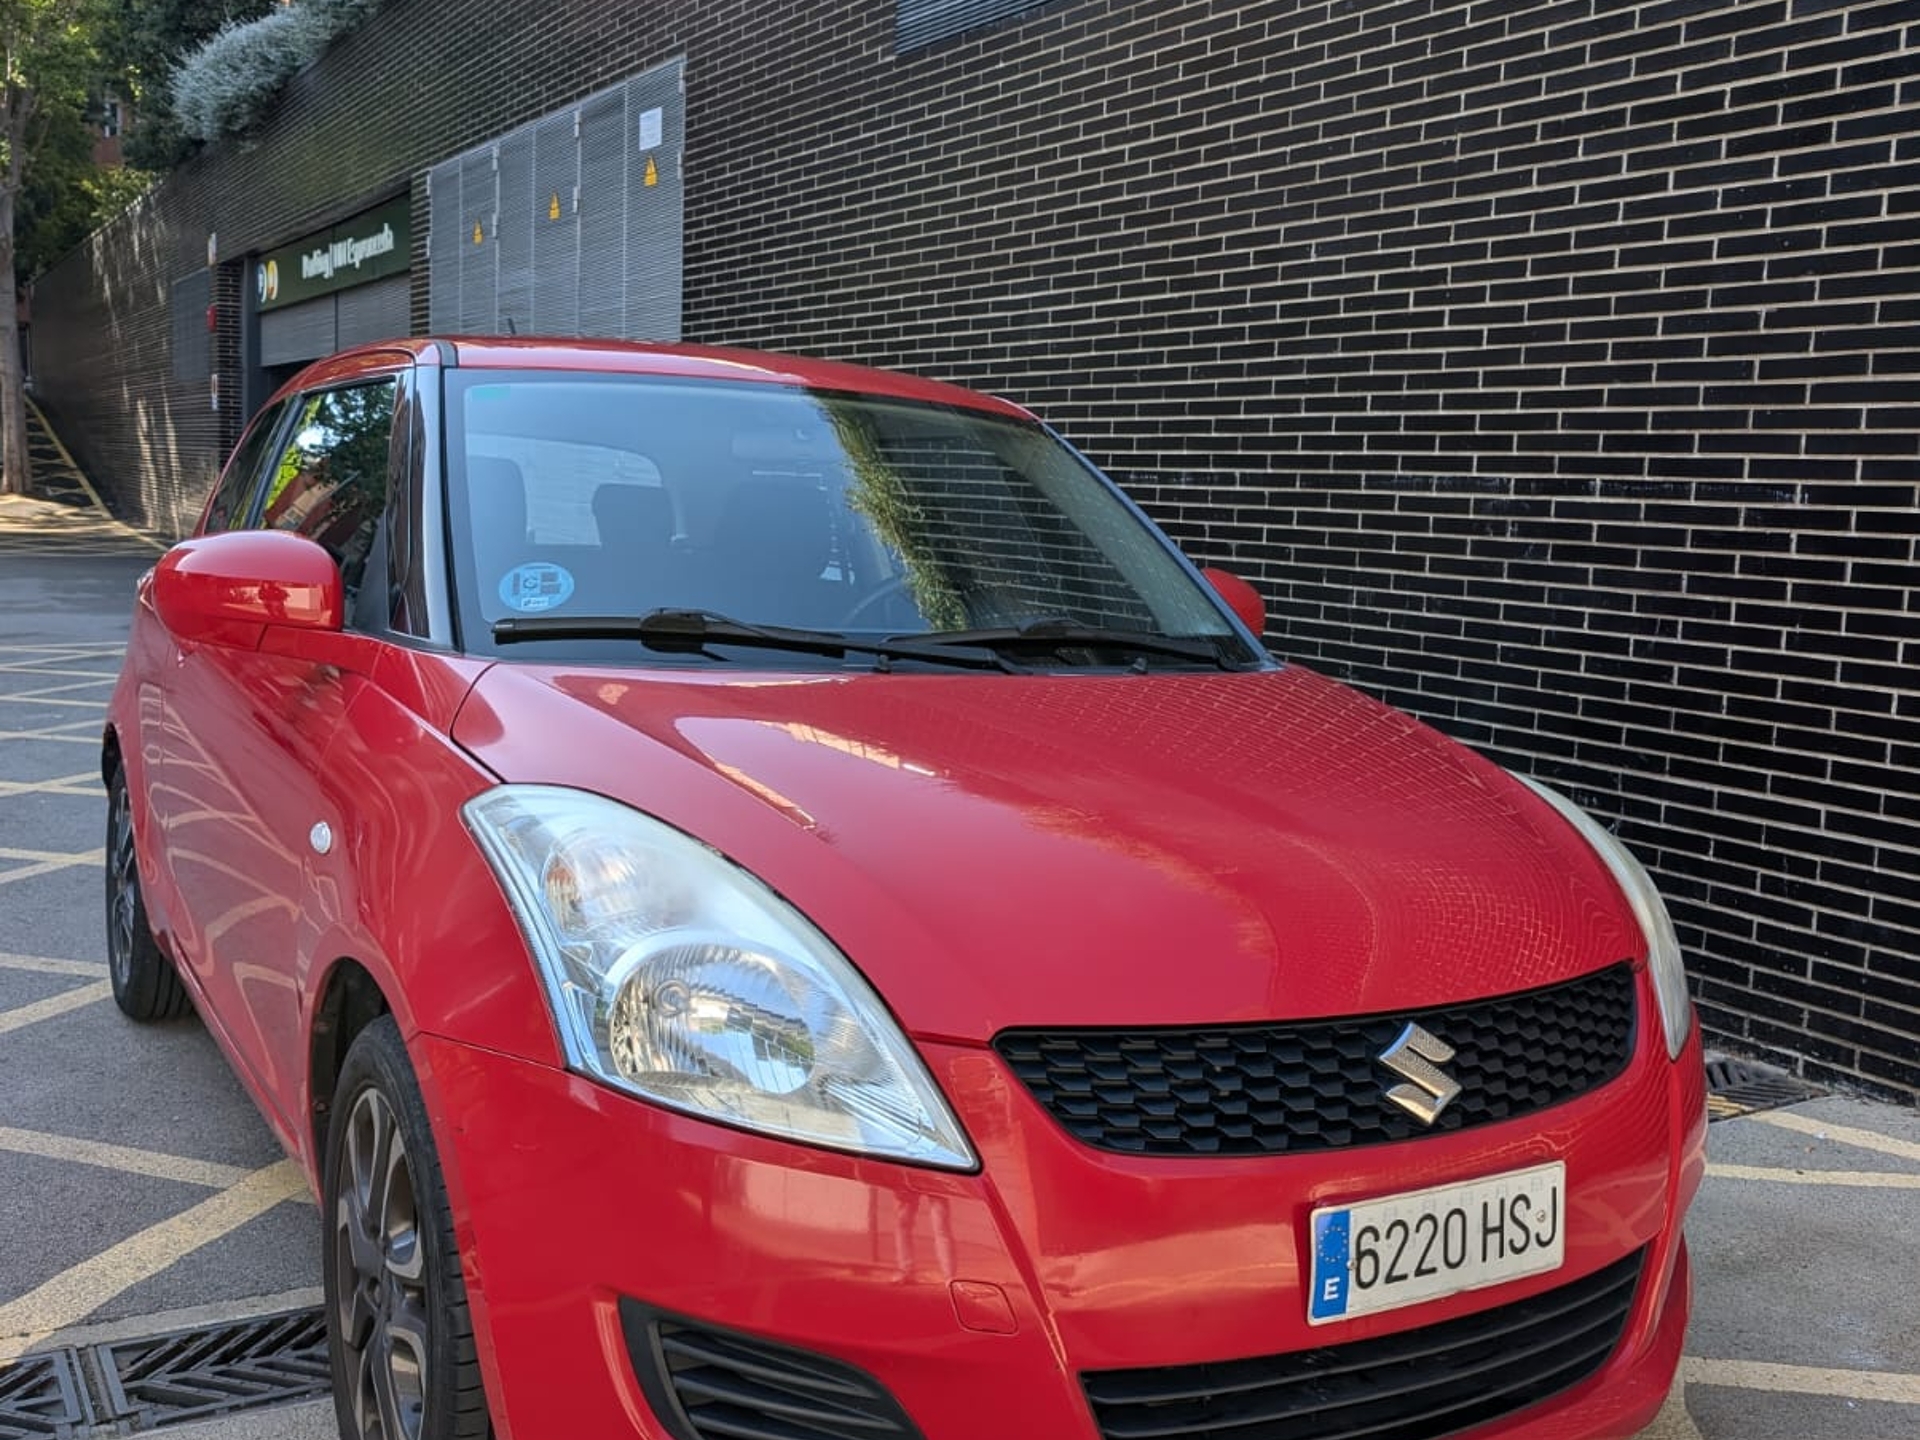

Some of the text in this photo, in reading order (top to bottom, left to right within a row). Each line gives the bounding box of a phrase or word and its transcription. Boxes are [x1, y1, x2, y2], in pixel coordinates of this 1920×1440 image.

[1354, 1186, 1558, 1290] 6220 HSJ
[1323, 1277, 1341, 1301] E
